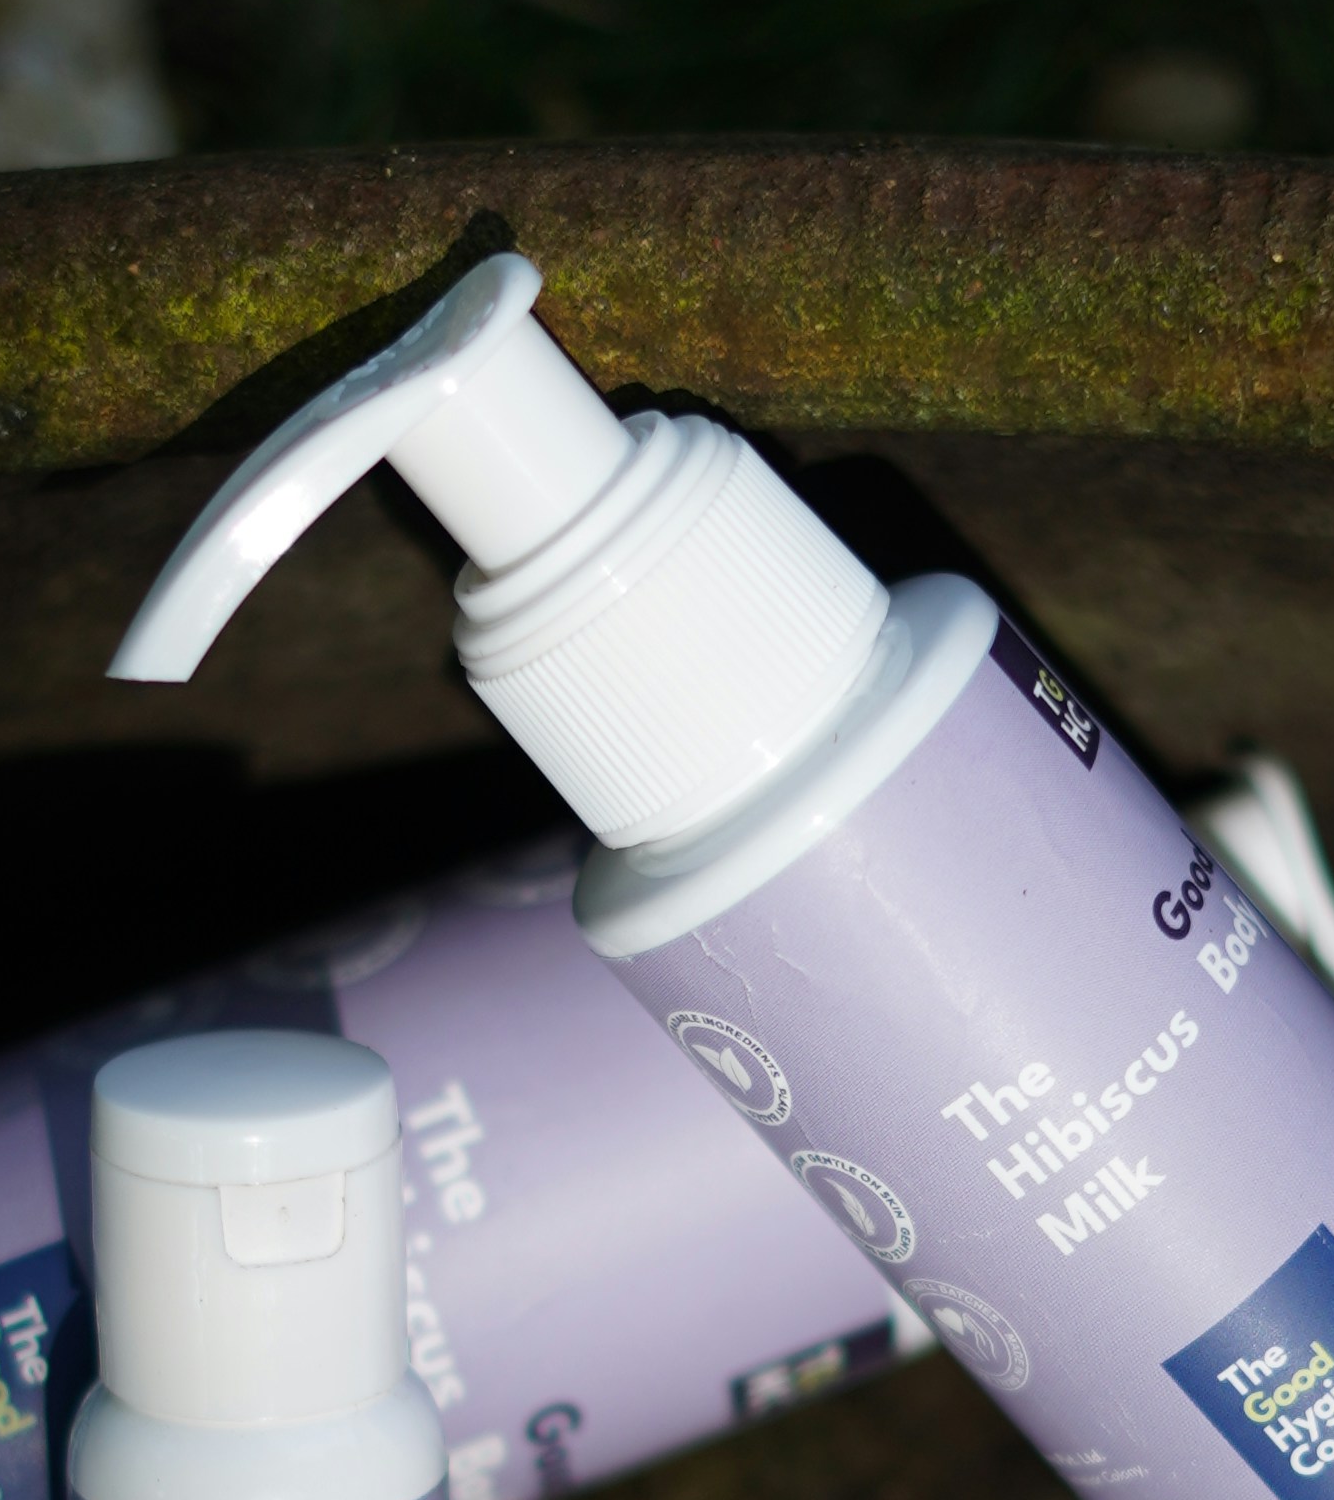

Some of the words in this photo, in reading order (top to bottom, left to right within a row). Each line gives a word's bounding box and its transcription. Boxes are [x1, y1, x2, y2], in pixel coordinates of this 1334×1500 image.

[1152, 828, 1214, 941] Good
[1196, 894, 1268, 995] Body
[700, 1015, 781, 1079] INGREDIENTS
[940, 1062, 1055, 1141] The
[986, 1010, 1199, 1200] Hibiscus
[408, 1081, 485, 1224] The
[807, 1153, 857, 1175] GENTLE
[860, 1173, 882, 1190] ON
[880, 1191, 906, 1219] SKIN
[1035, 1155, 1166, 1256] Milk
[0, 1294, 49, 1385] The
[1217, 1346, 1288, 1396] The
